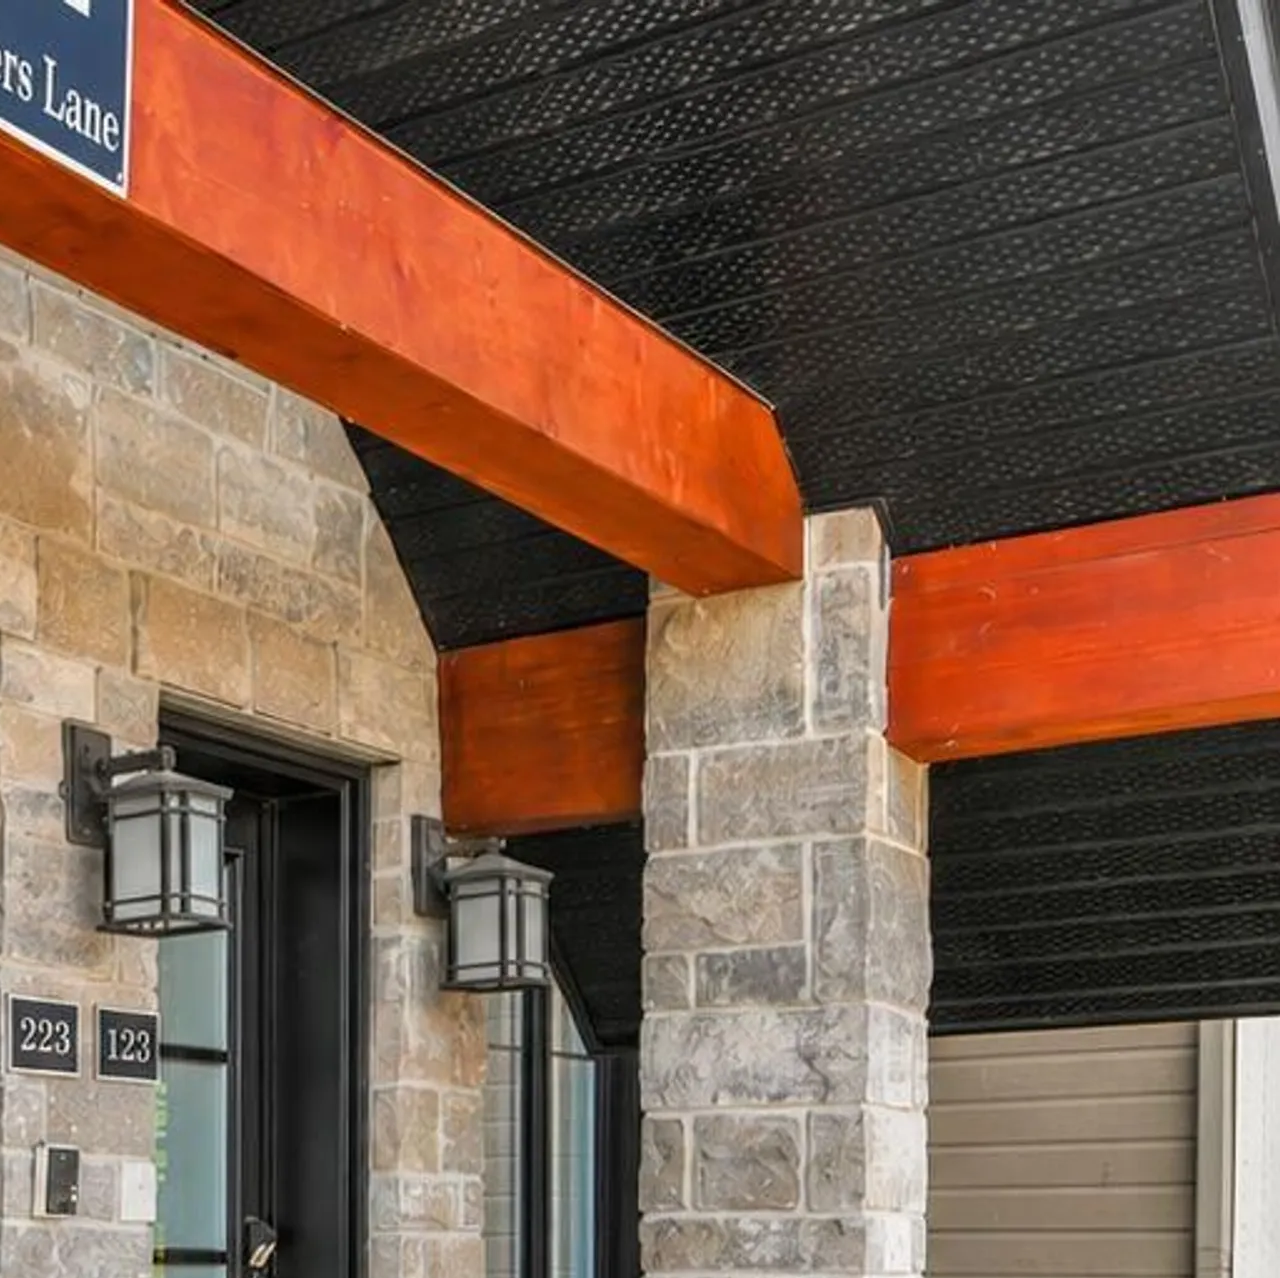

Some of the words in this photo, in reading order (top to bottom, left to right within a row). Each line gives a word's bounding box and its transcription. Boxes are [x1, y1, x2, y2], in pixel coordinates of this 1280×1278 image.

[42, 54, 121, 152] Lane
[19, 1016, 71, 1056] 223
[107, 1027, 151, 1063] 123
